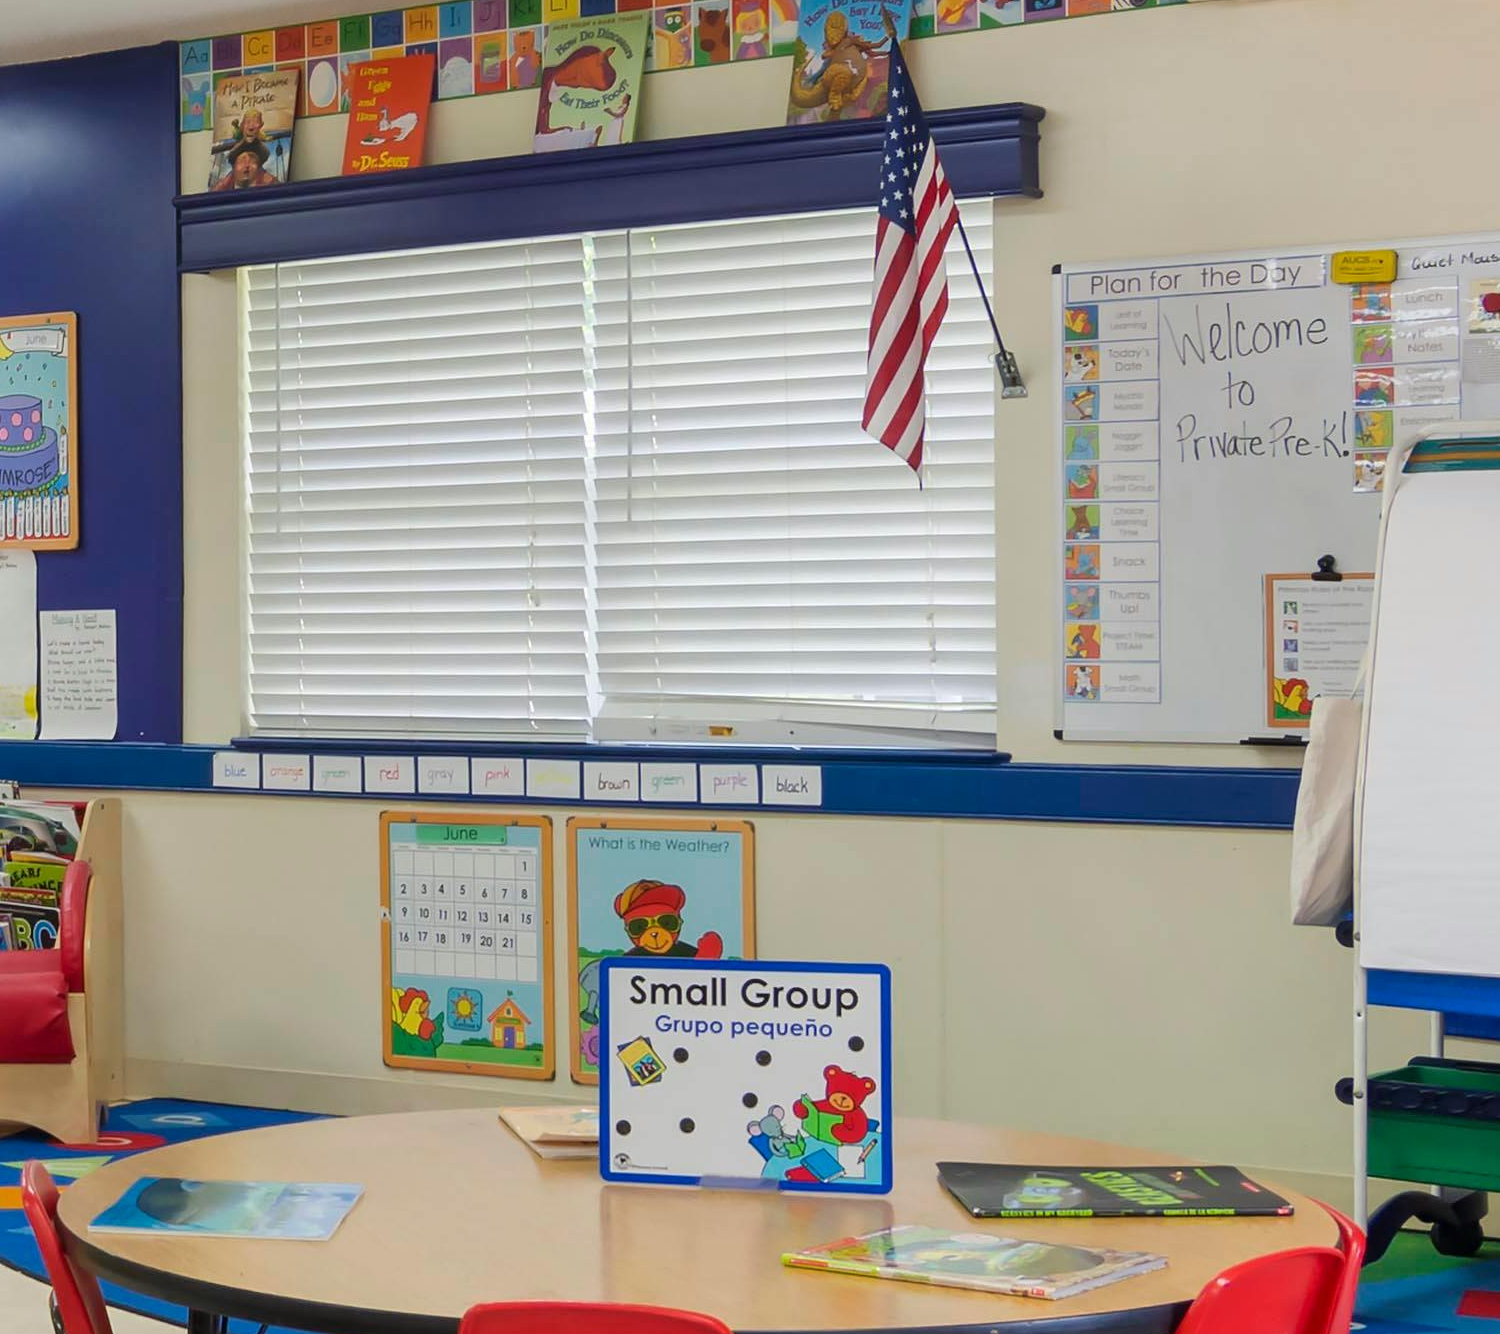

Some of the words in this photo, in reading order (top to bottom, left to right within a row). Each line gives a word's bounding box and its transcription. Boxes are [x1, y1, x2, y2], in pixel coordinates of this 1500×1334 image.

[580, 30, 594, 42] Do
[575, 98, 600, 109] Their
[379, 152, 410, 169] Seuss
[1091, 275, 1141, 295] Plan
[1150, 270, 1182, 292] for
[1200, 266, 1241, 288] the
[1250, 264, 1302, 286] Day
[1164, 303, 1329, 366] Welcome
[1407, 343, 1444, 353] Notes
[1220, 371, 1255, 409] to
[1176, 413, 1266, 463] Private
[1269, 410, 1350, 459] Pre-K!
[224, 763, 247, 777] blue
[270, 766, 304, 782] orange
[379, 766, 399, 781] red
[427, 768, 455, 786] gray
[485, 767, 511, 787] pink
[598, 772, 630, 791] brown
[652, 775, 684, 791] green
[713, 772, 749, 790] purple
[776, 775, 809, 794] black
[443, 827, 478, 841] June
[588, 836, 623, 850] What
[627, 837, 636, 851] is
[639, 837, 661, 851] the
[665, 839, 730, 853] Weather?
[522, 861, 527, 872] 1
[400, 883, 407, 894] 2
[420, 883, 427, 894] 3
[438, 884, 445, 894] 4
[459, 884, 466, 895] 5
[481, 887, 488, 898] 6
[501, 888, 508, 899] 7
[521, 888, 528, 899] 8
[401, 906, 408, 917] 9
[419, 907, 430, 919] 10
[439, 909, 448, 920] 11
[457, 910, 468, 921] 12
[478, 911, 489, 923] 13
[498, 913, 509, 924] 14
[520, 913, 532, 924] 15
[399, 931, 410, 942] 16
[417, 931, 428, 942] 17
[435, 933, 446, 944] 18
[461, 932, 472, 943] 19
[479, 935, 493, 947] 20
[501, 937, 514, 948] 21
[629, 974, 727, 1006] Small
[740, 978, 859, 1017] Group
[655, 1014, 723, 1037] Grupo
[730, 1018, 833, 1040] pequeño
